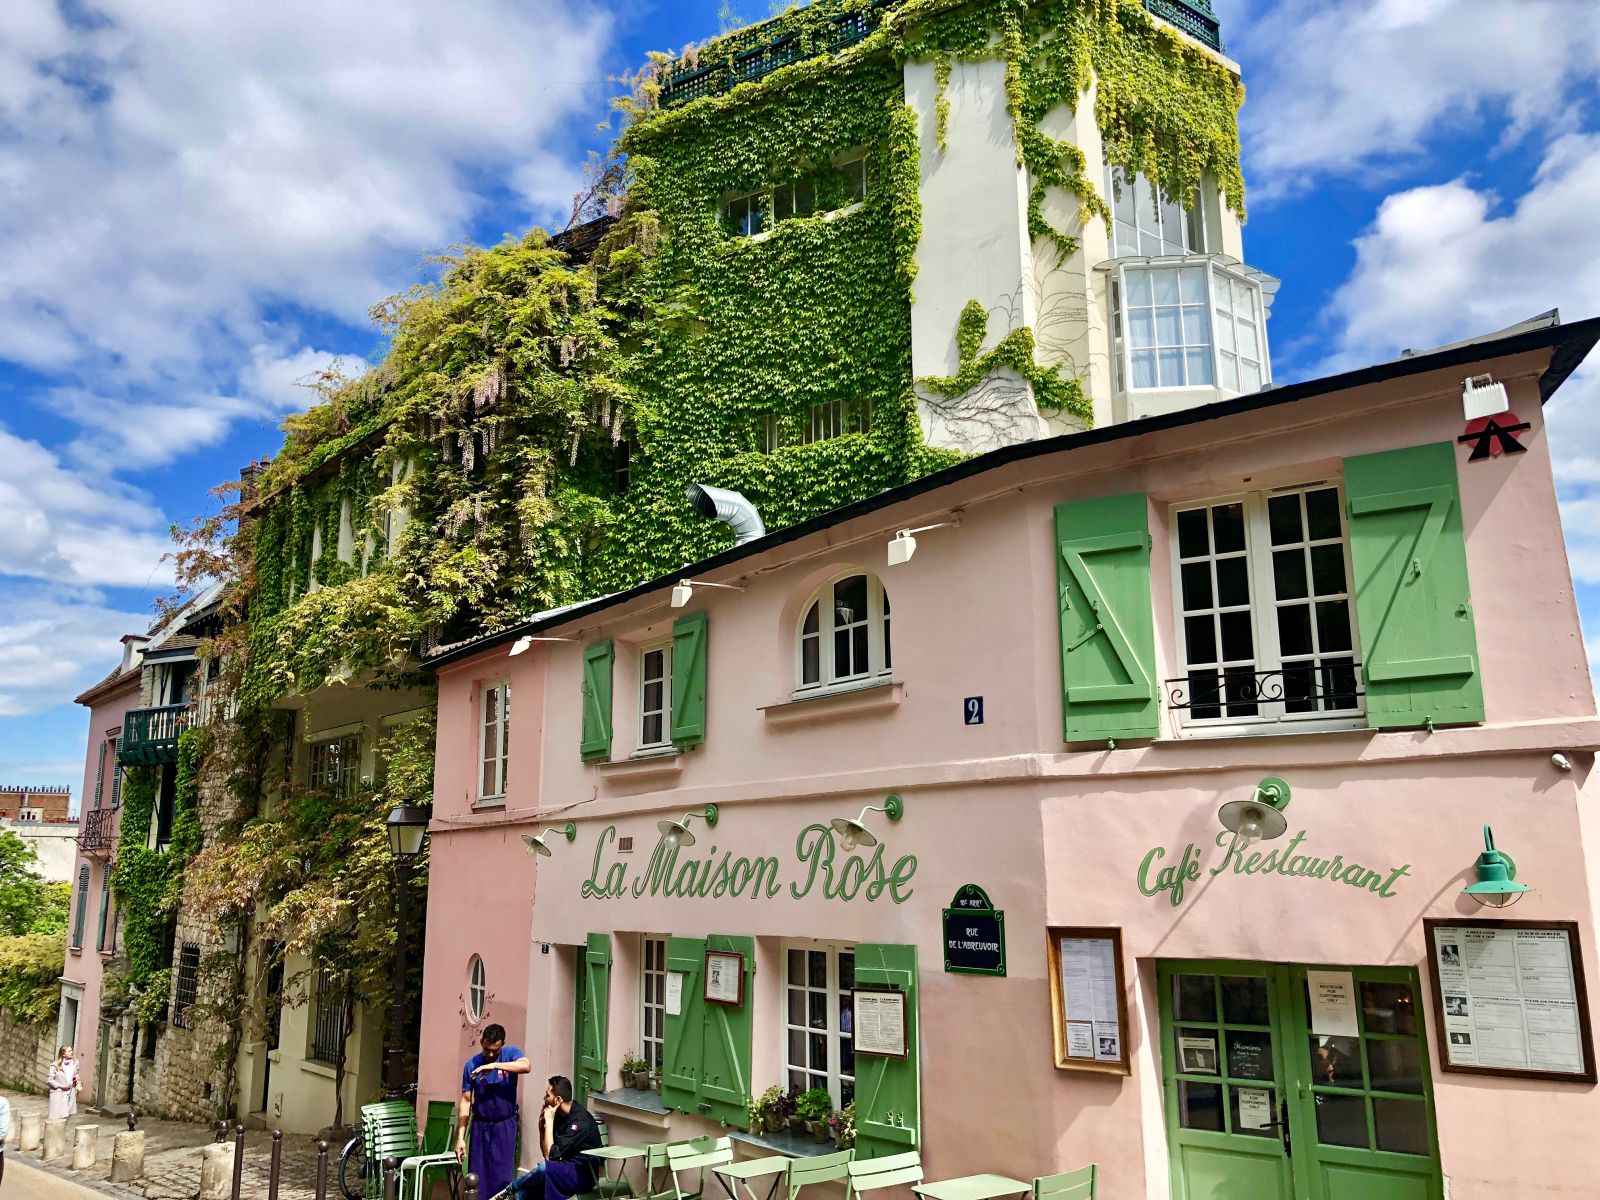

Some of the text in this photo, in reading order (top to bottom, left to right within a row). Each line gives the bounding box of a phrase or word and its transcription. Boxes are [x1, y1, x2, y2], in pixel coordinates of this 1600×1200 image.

[967, 699, 980, 724] 2
[580, 818, 918, 905] La Maison Rose
[1137, 829, 1412, 907] Café Restaurant
[965, 927, 979, 938] RUE
[948, 940, 999, 953] DE L'ABREUVOIR
